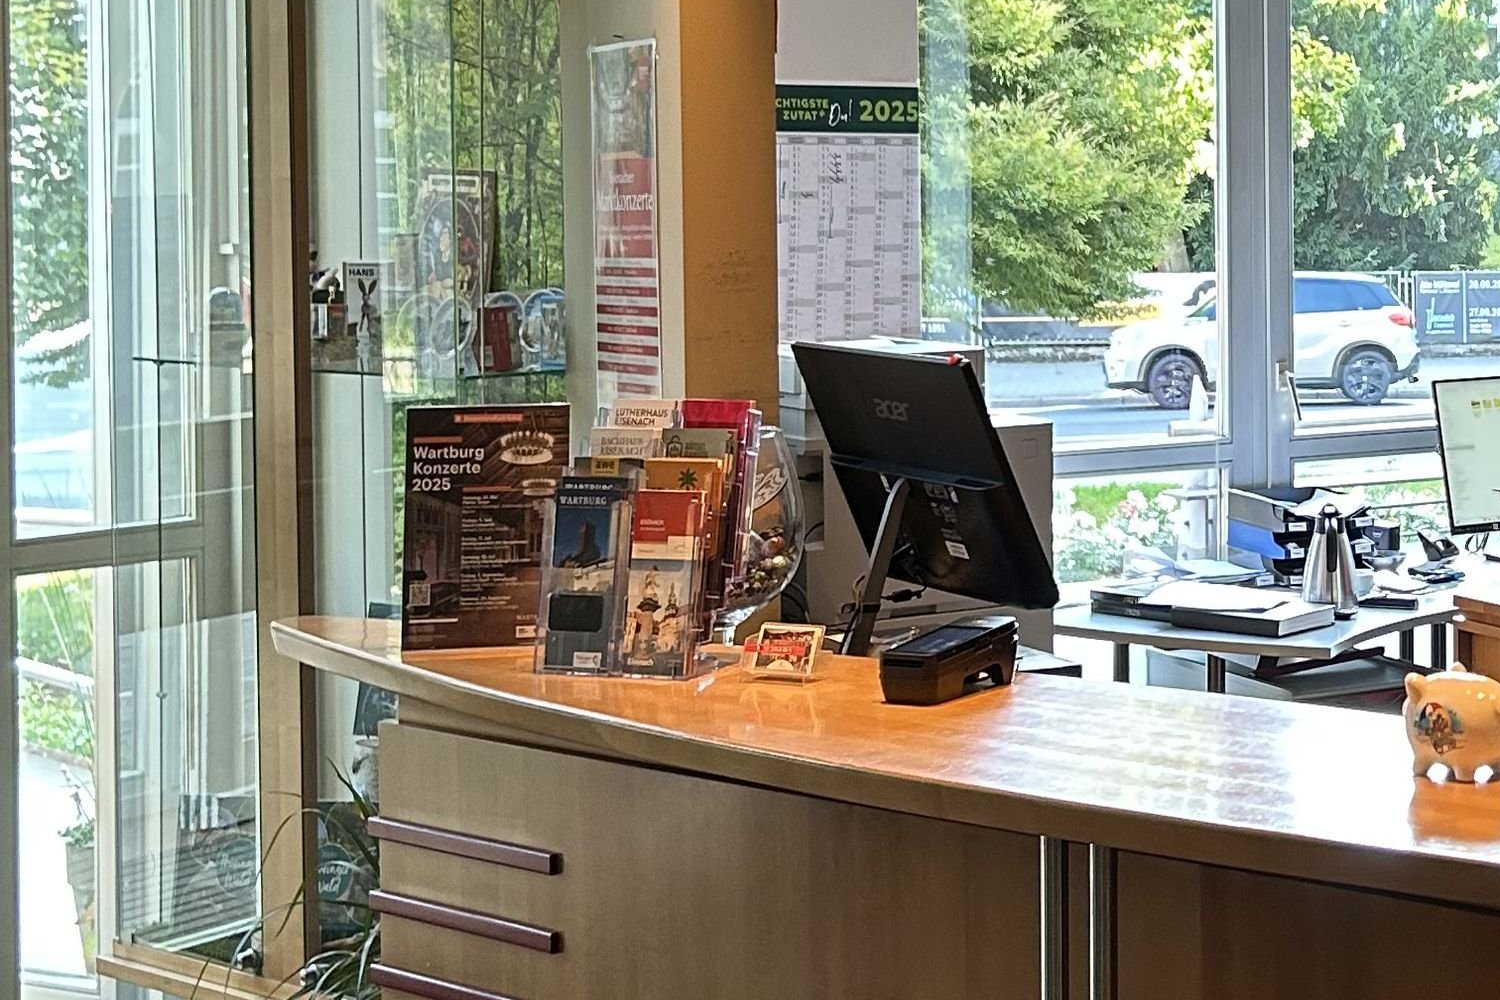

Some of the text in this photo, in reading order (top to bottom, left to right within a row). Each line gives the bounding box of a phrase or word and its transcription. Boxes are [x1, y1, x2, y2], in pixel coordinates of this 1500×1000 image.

[859, 100, 919, 122] 2025
[615, 408, 669, 419] LUTHERHAUS
[873, 398, 910, 422] acer
[614, 417, 655, 426] EISENACH
[413, 446, 485, 461] Wartburg
[413, 462, 481, 475] Konzerte
[412, 478, 451, 491] 2025
[559, 495, 607, 506] WARTBURG
